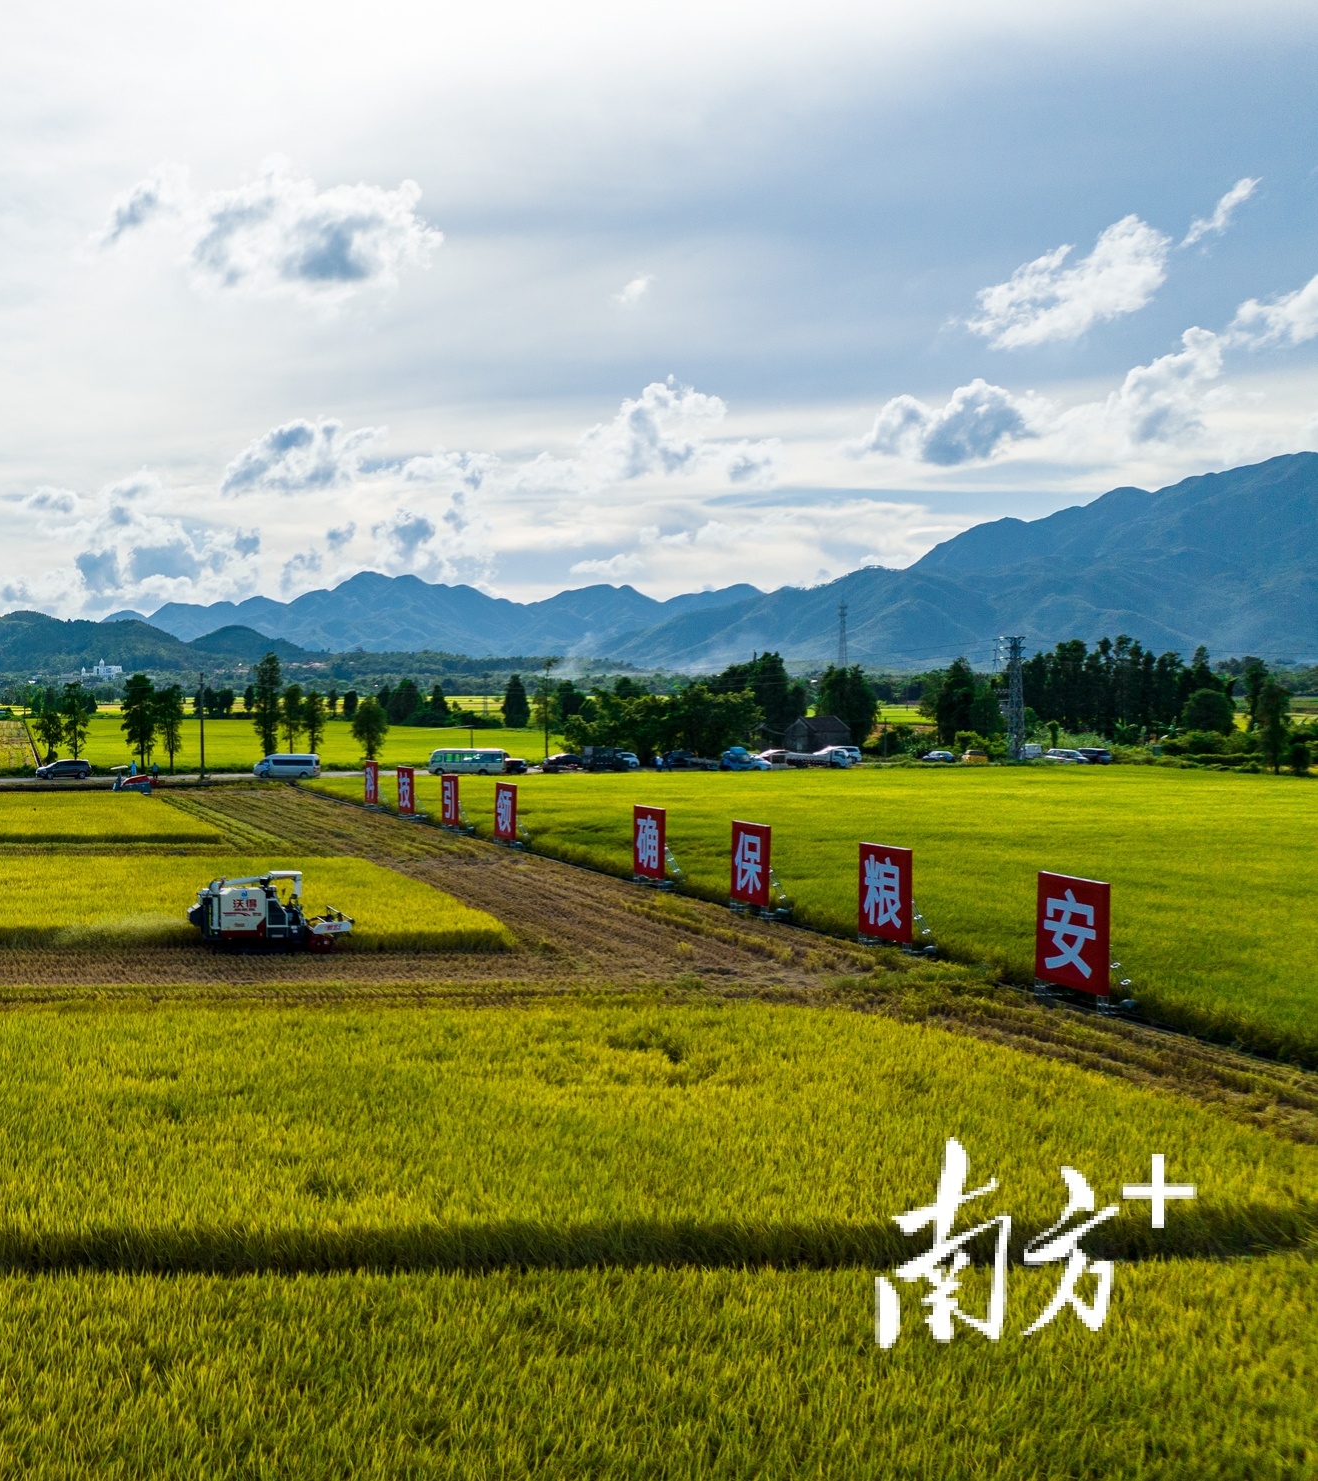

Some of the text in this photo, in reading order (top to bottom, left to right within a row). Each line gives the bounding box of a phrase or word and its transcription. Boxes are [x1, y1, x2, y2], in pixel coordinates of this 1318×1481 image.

[365, 766, 375, 800] 科
[398, 771, 411, 808] 技
[443, 780, 455, 820] 引
[496, 788, 513, 833] 领
[635, 814, 659, 870] 确
[734, 830, 762, 895] 保
[863, 853, 902, 929] 粮
[1043, 888, 1097, 979] 安
